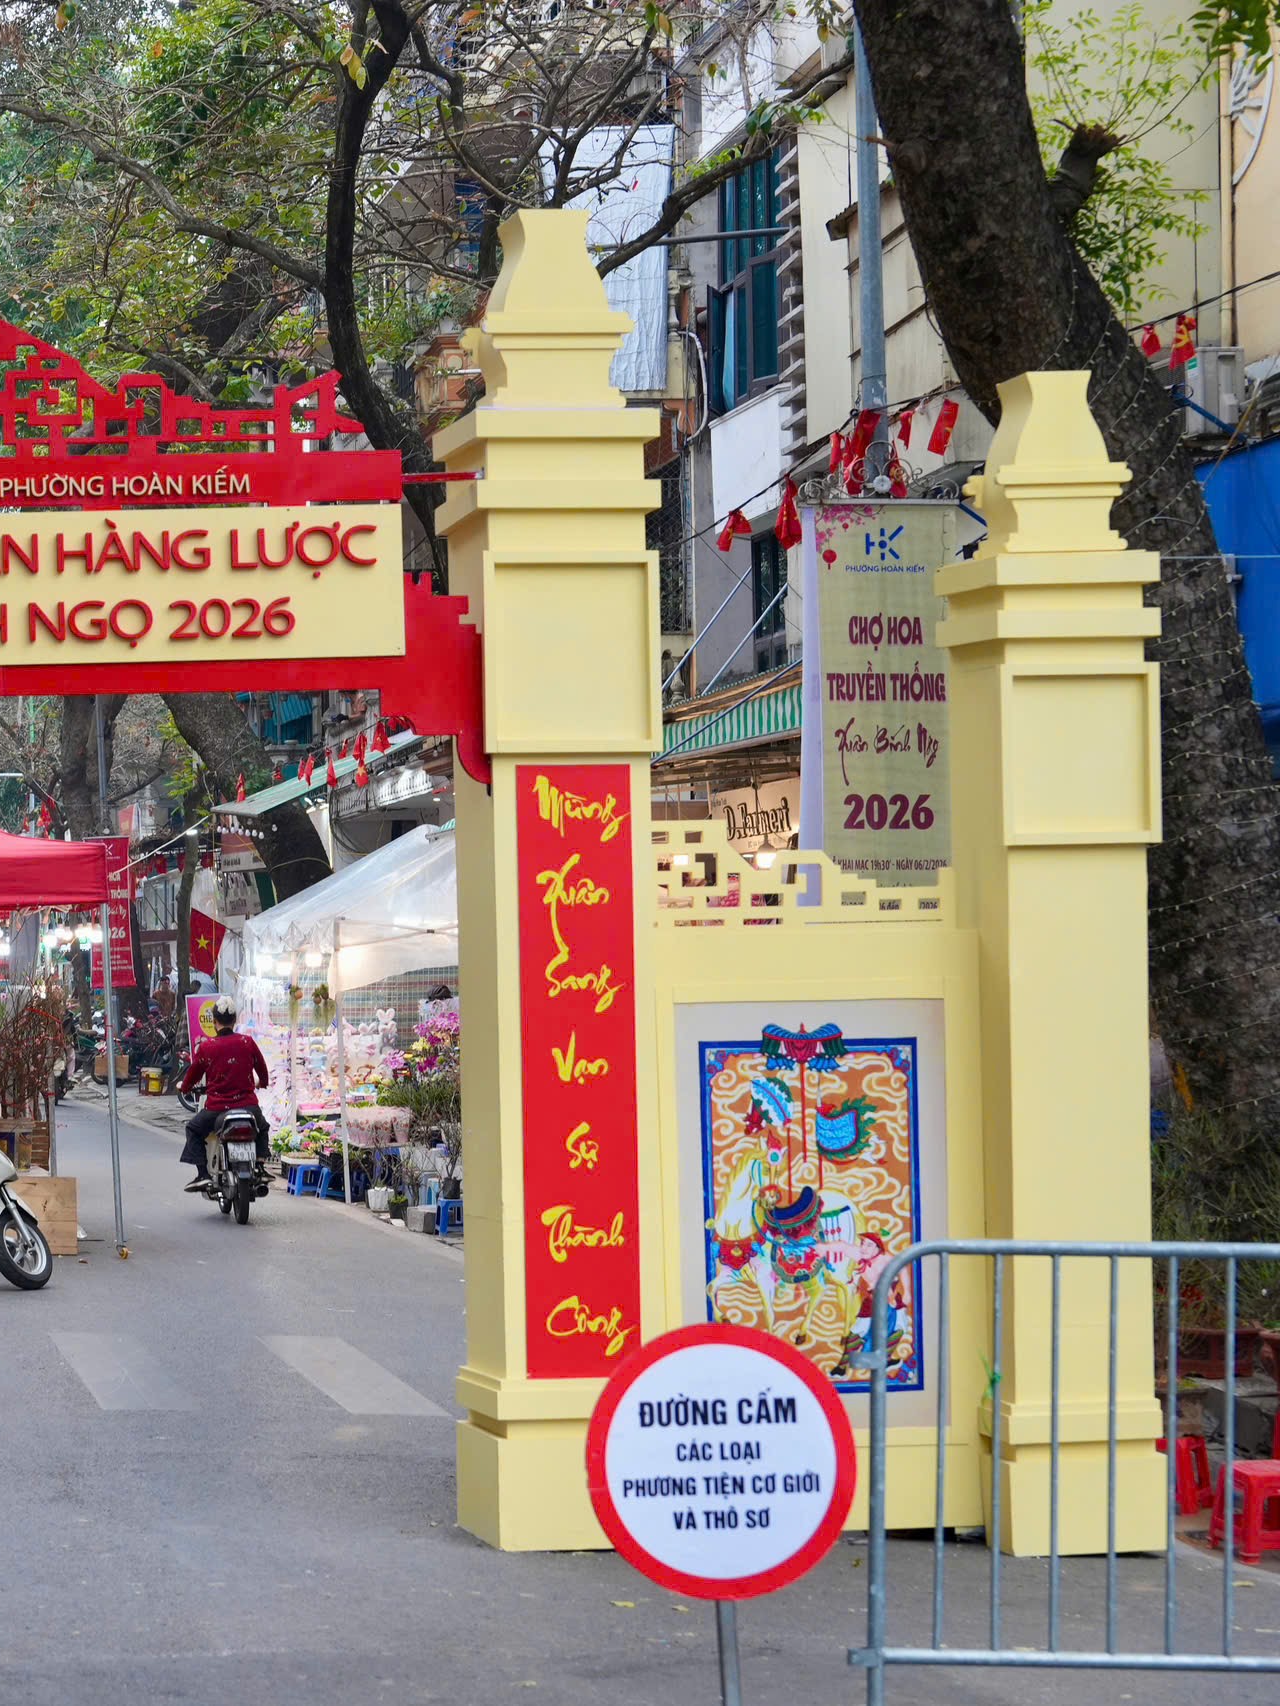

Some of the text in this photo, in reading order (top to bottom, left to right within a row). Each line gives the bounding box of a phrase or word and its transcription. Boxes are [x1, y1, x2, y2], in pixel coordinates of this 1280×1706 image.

[0, 472, 104, 498] PHƯỜNG
[111, 473, 183, 496] HOÀN
[191, 465, 251, 495] KIẾM
[56, 517, 212, 573] HÀNG
[230, 520, 378, 579] LƯỢC
[28, 599, 154, 649] NGỌ
[169, 596, 296, 642] 2026
[849, 612, 923, 651] CHỢ HOA
[826, 660, 946, 702] TRUYỀN THỐNG
[843, 793, 935, 831] 2026
[532, 774, 638, 1357] Mừng Xuân Sang Vạn Sự Thành Công
[639, 1387, 797, 1428] ĐƯỜNG CẤM
[676, 1438, 761, 1465] CÁC LOẠI
[623, 1469, 820, 1500] PHƯƠNG TIỆN CƠ GIỚI
[673, 1506, 697, 1530] VÀ
[746, 1507, 771, 1528] SƠ
